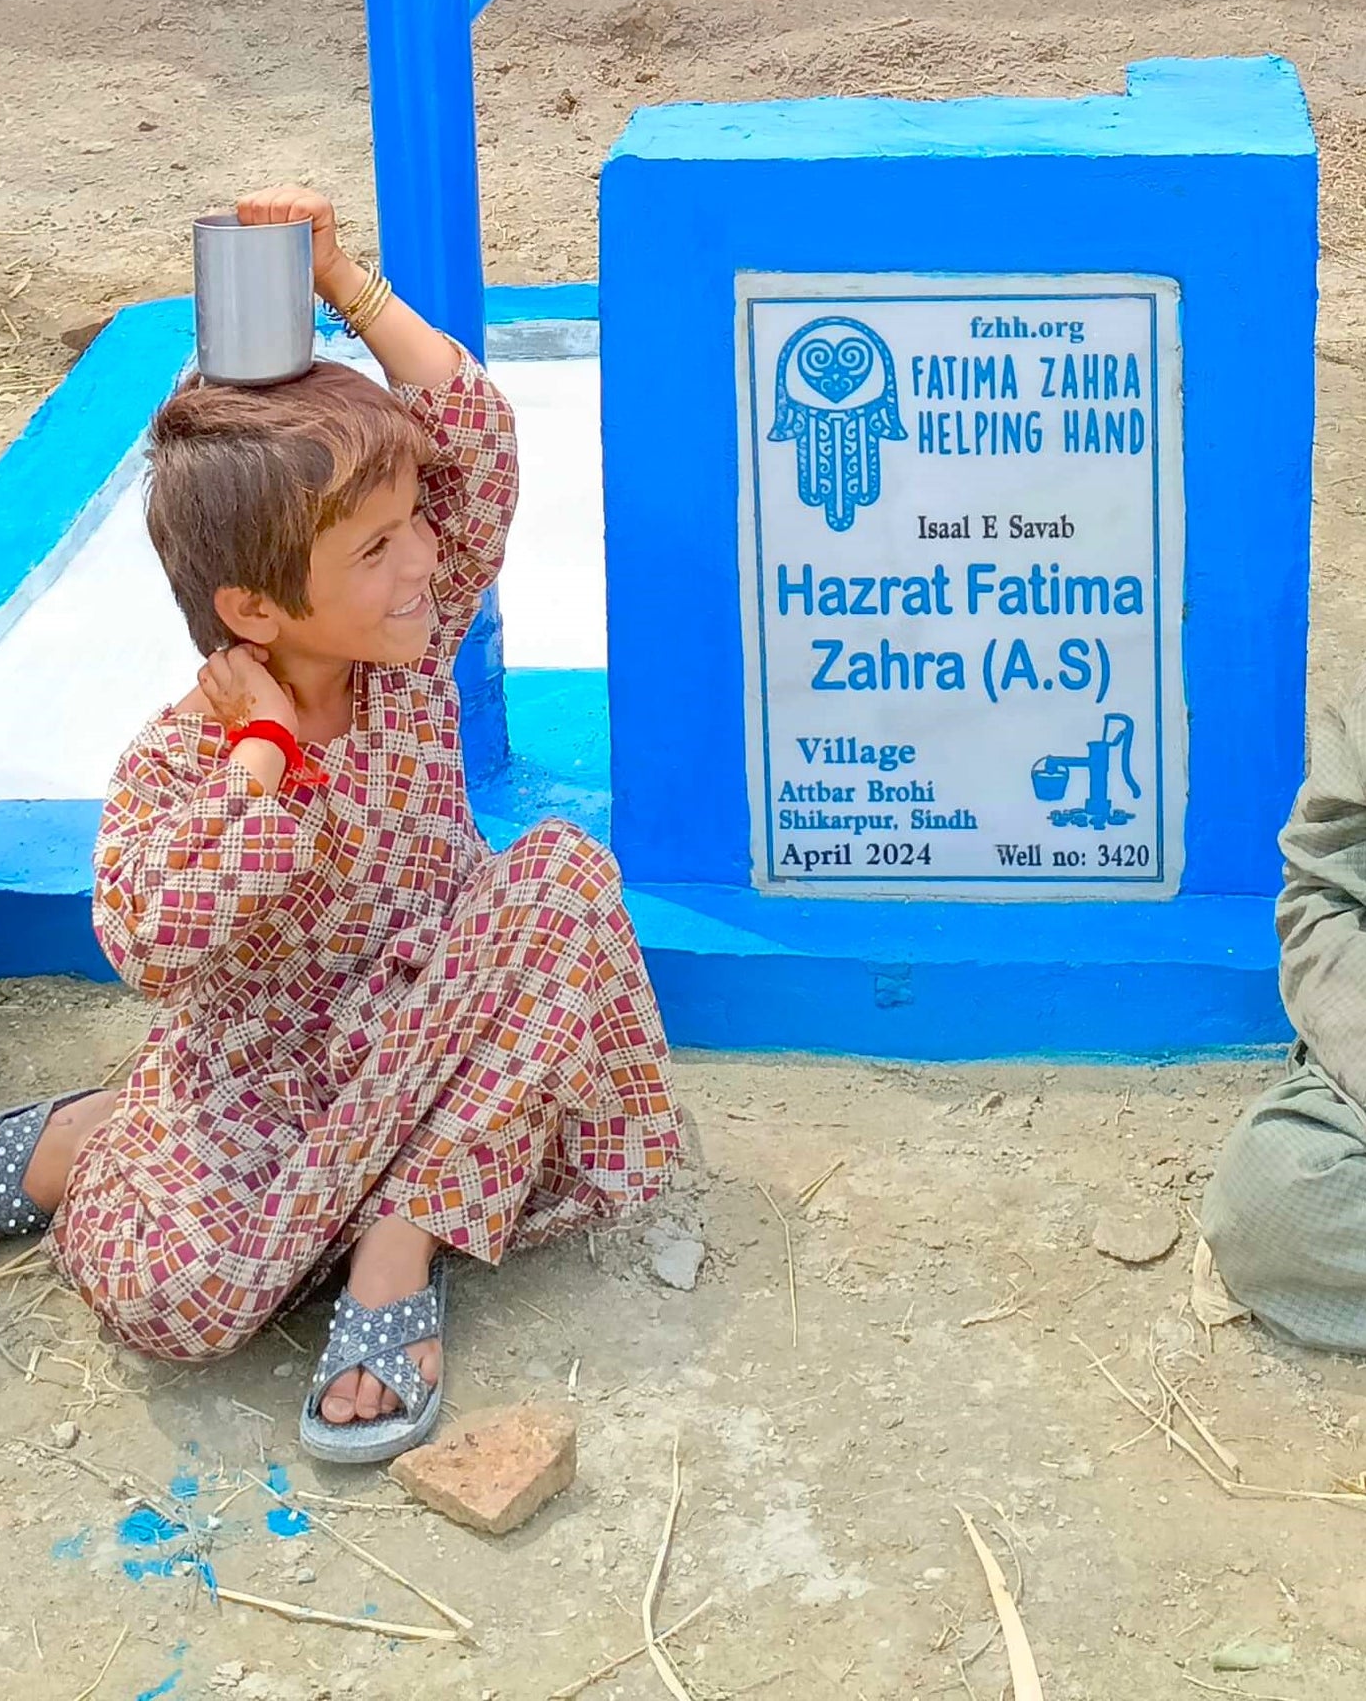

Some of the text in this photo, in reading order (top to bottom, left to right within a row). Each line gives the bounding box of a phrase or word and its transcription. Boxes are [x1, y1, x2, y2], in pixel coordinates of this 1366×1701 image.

[970, 316, 1084, 344] fzhh.org
[912, 353, 1141, 401] FATIMA ZAHRA
[919, 407, 1145, 456] HELPING HAND
[918, 515, 1074, 539] Isaal E Savab
[777, 563, 1144, 616] Hazrat Fatima
[811, 638, 1111, 704] Zahra (A.S)
[796, 736, 916, 772] Village
[777, 780, 935, 804] Attbar Brohi
[911, 808, 978, 832] Sindh
[780, 840, 931, 869] April 2024
[995, 844, 1150, 867] Well no: 3420
